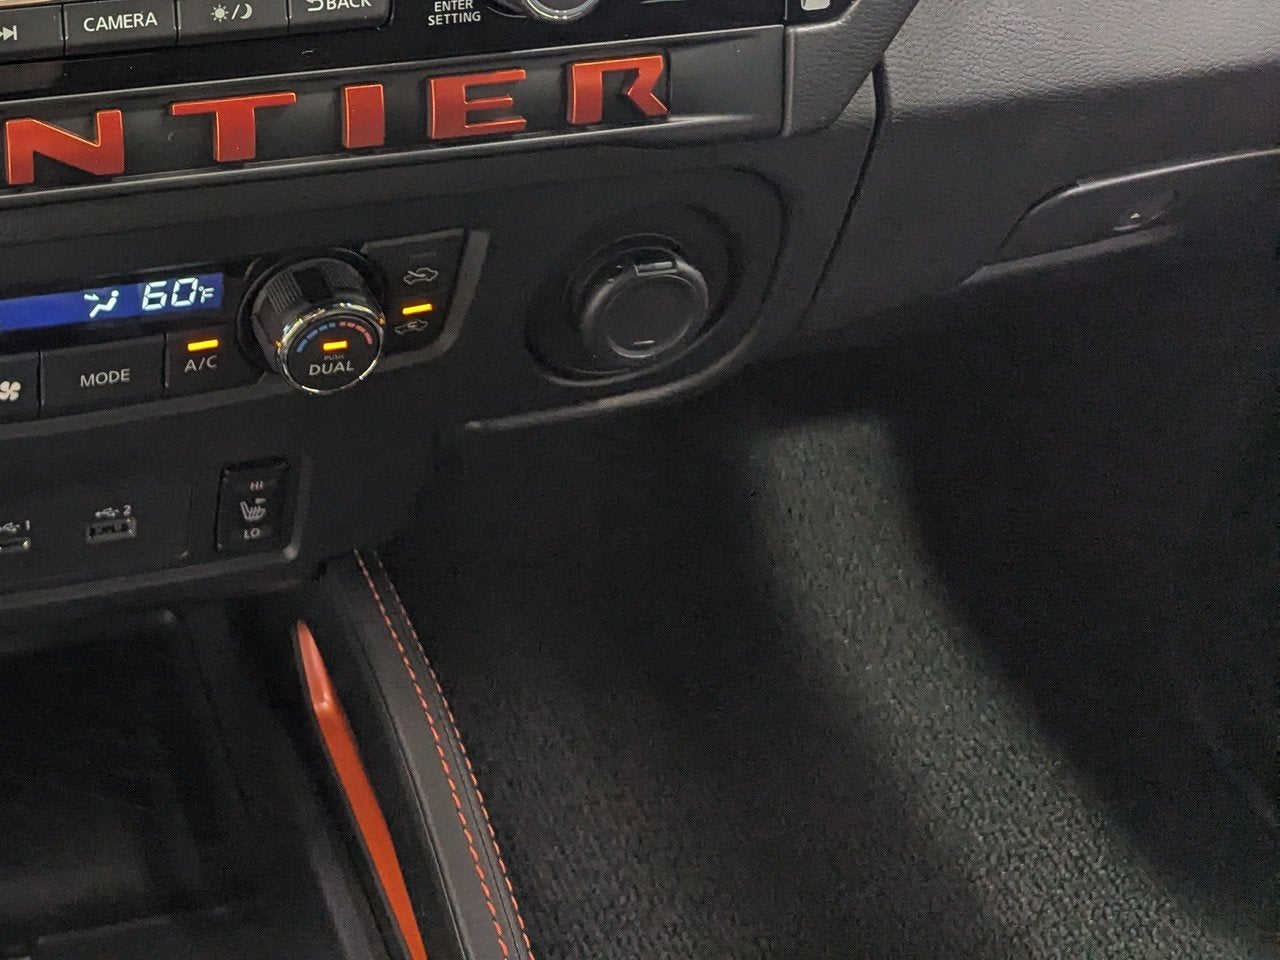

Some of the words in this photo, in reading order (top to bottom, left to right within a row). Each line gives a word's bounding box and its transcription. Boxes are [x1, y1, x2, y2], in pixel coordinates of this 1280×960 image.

[434, 0, 474, 13] ENTER
[83, 12, 158, 31] CAMERA
[428, 11, 481, 26] SETTING
[183, 355, 218, 374] A/C
[309, 361, 355, 376] DUAL
[80, 369, 130, 388] MODE
